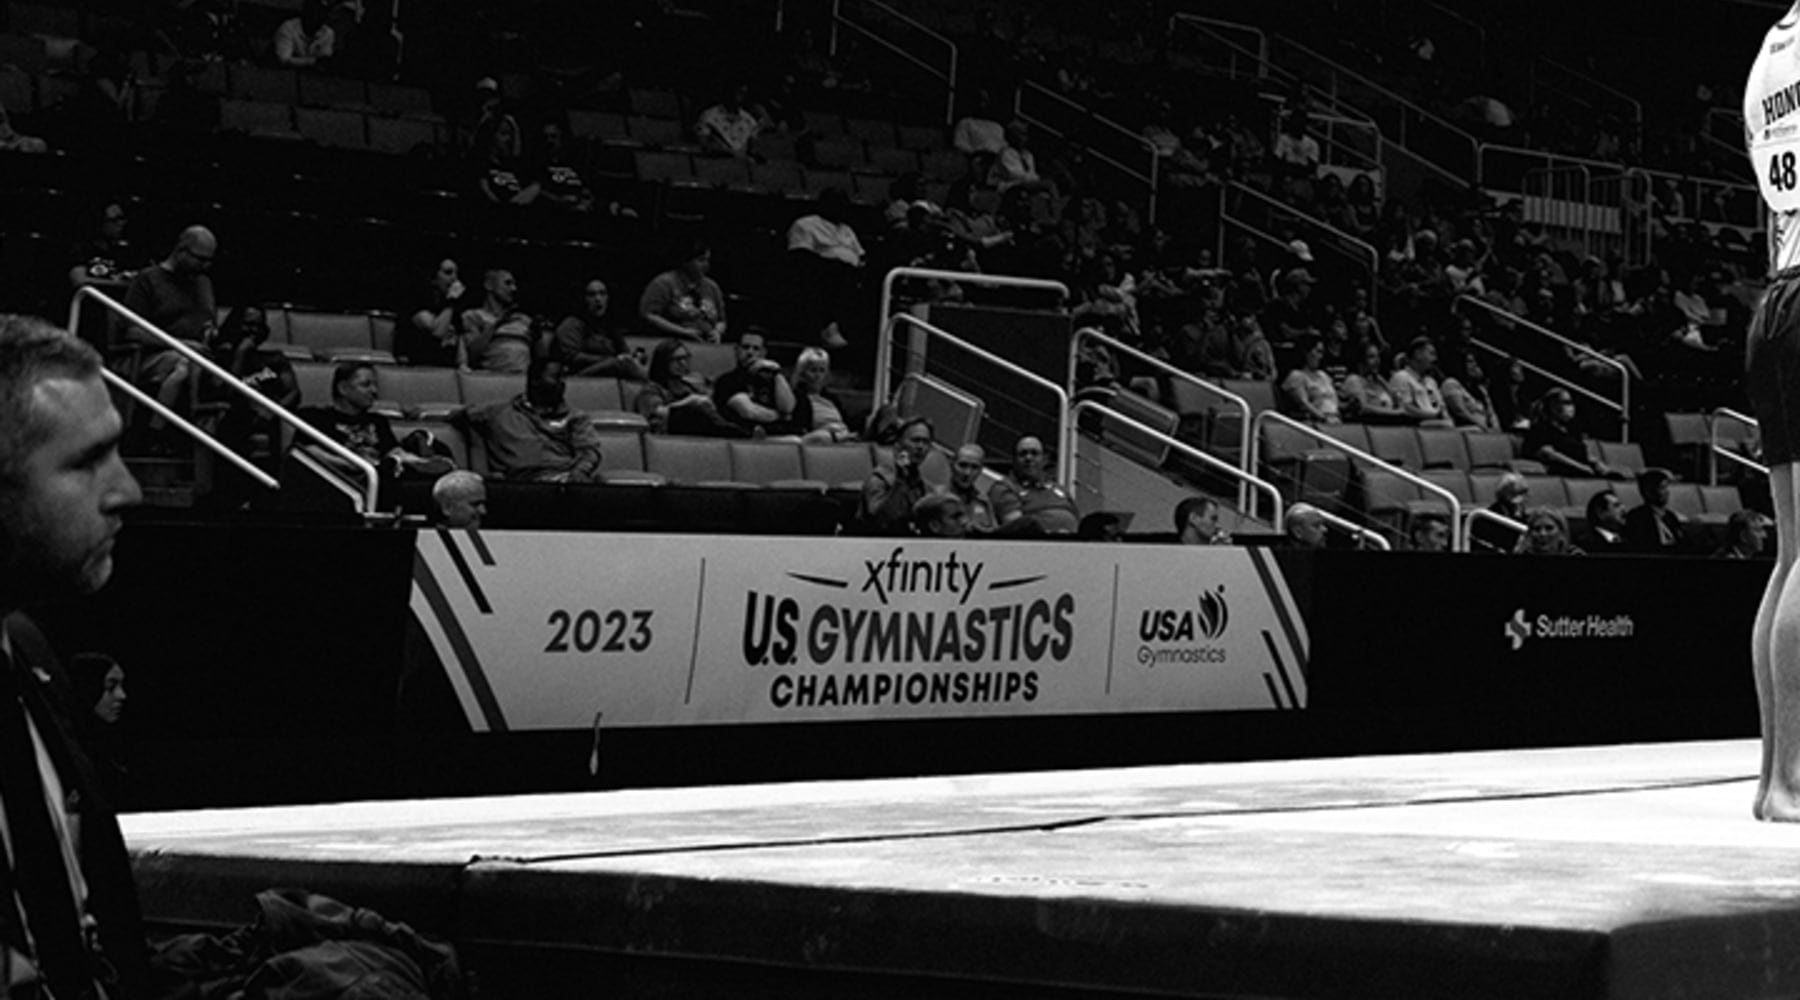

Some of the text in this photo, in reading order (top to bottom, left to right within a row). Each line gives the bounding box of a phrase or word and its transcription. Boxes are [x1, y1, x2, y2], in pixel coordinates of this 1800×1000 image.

[1768, 151, 1797, 192] 48
[861, 546, 985, 606] xfinity
[543, 609, 654, 654] 2023
[743, 590, 1076, 667] U.S. GYMNASTICS
[1139, 609, 1195, 643] USA
[1536, 614, 1634, 638] Sutter Health
[1136, 645, 1227, 669] Gymnastics
[769, 670, 1040, 709] CHAMPIONSHIPS
